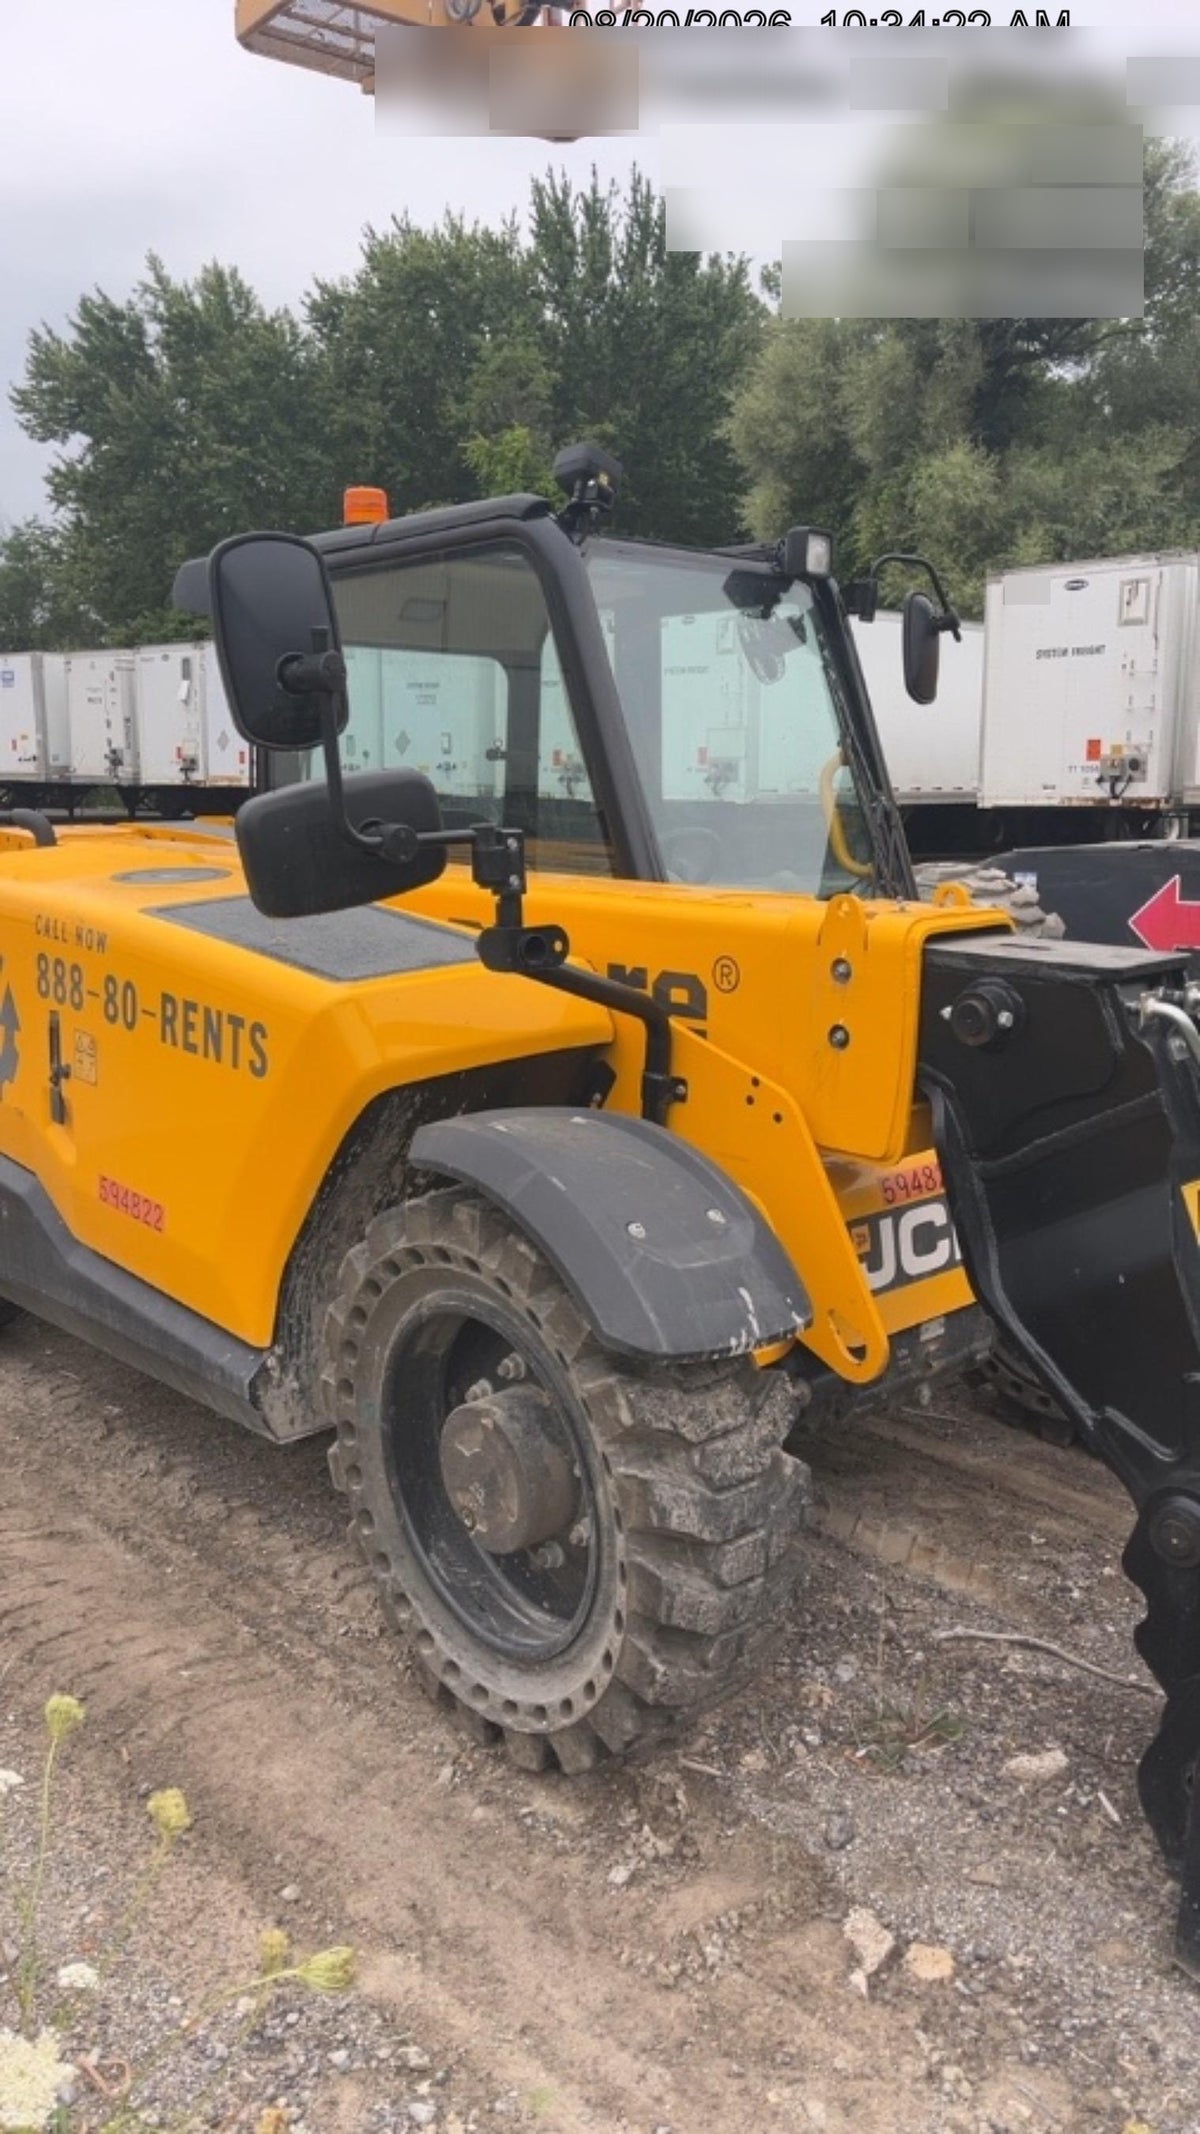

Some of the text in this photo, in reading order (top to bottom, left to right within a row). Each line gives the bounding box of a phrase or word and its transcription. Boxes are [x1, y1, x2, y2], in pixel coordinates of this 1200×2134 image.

[35, 914, 108, 954] CALL NOW
[37, 952, 268, 1078] 888-80-RENTS
[99, 1175, 164, 1233] 594822
[882, 1165, 943, 1203] 5948
[863, 1202, 963, 1290] JC
